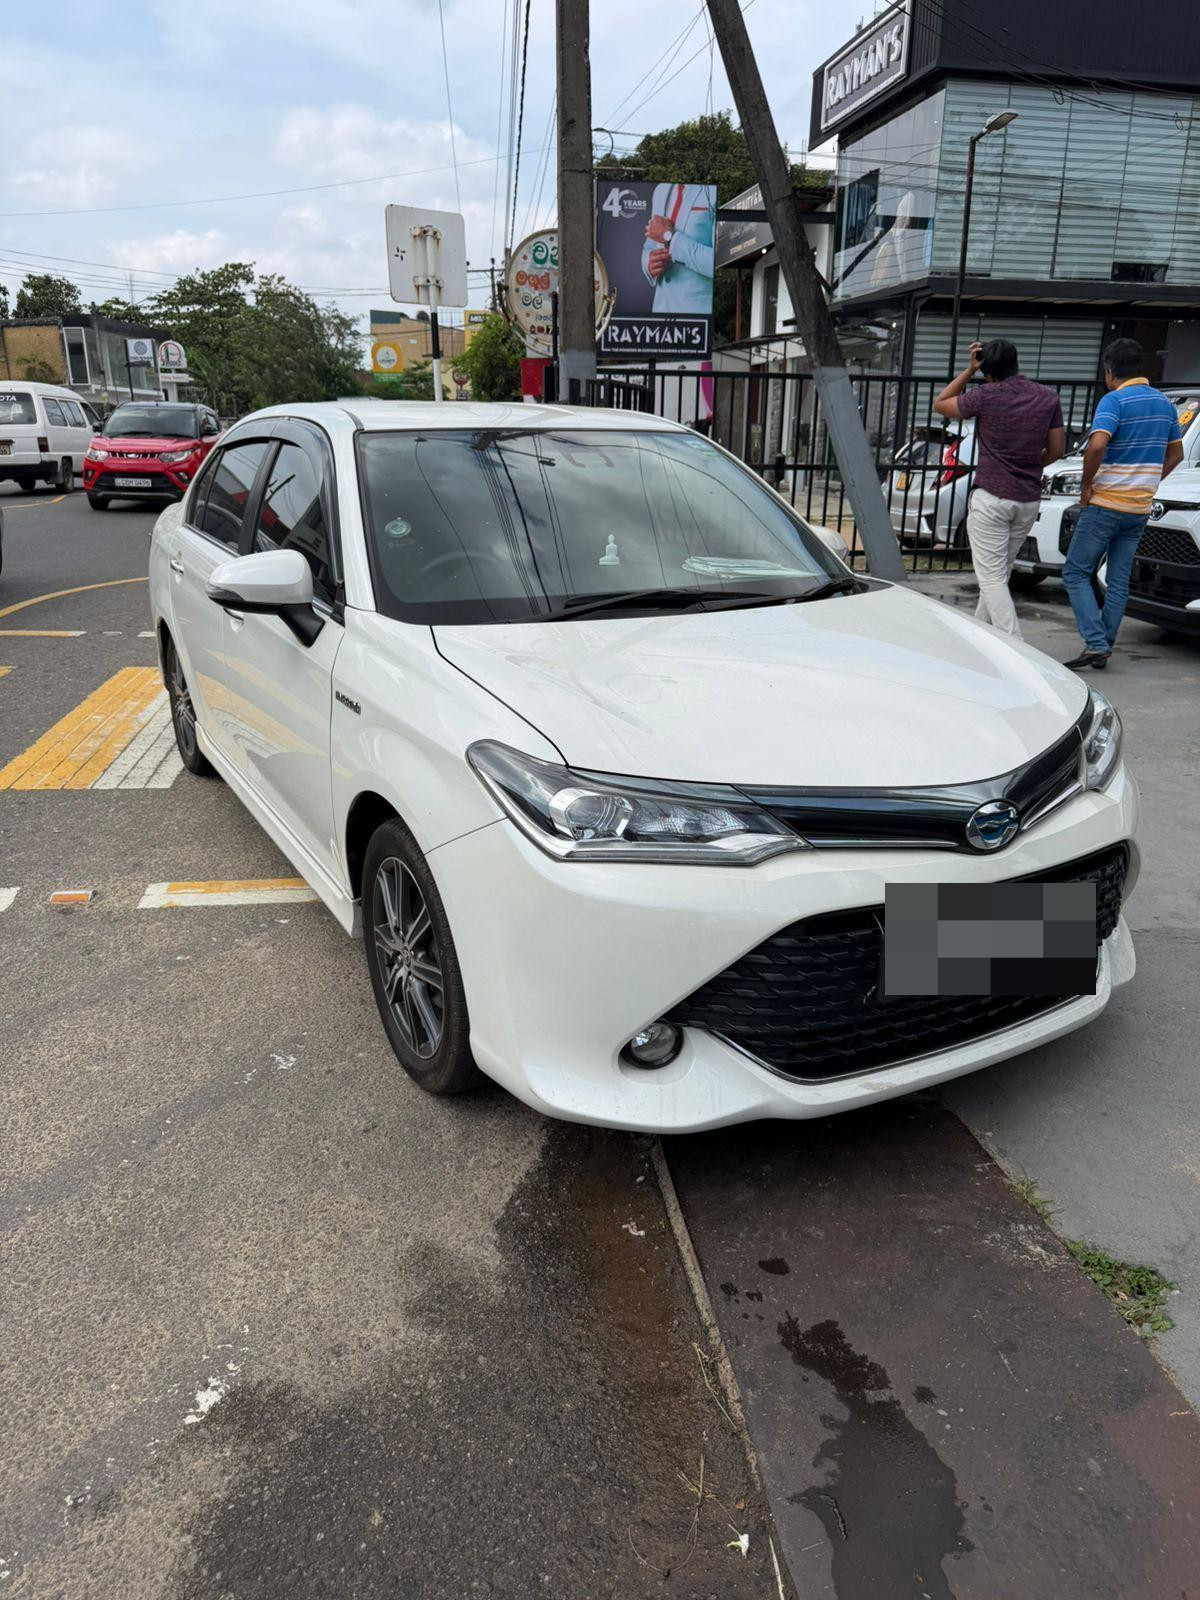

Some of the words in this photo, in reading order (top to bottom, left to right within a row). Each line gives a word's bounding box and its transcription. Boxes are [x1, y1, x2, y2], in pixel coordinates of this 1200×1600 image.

[826, 24, 902, 109] RAYMAN'S
[623, 200, 648, 208] YEARS
[608, 325, 701, 344] RAYMAN'S
